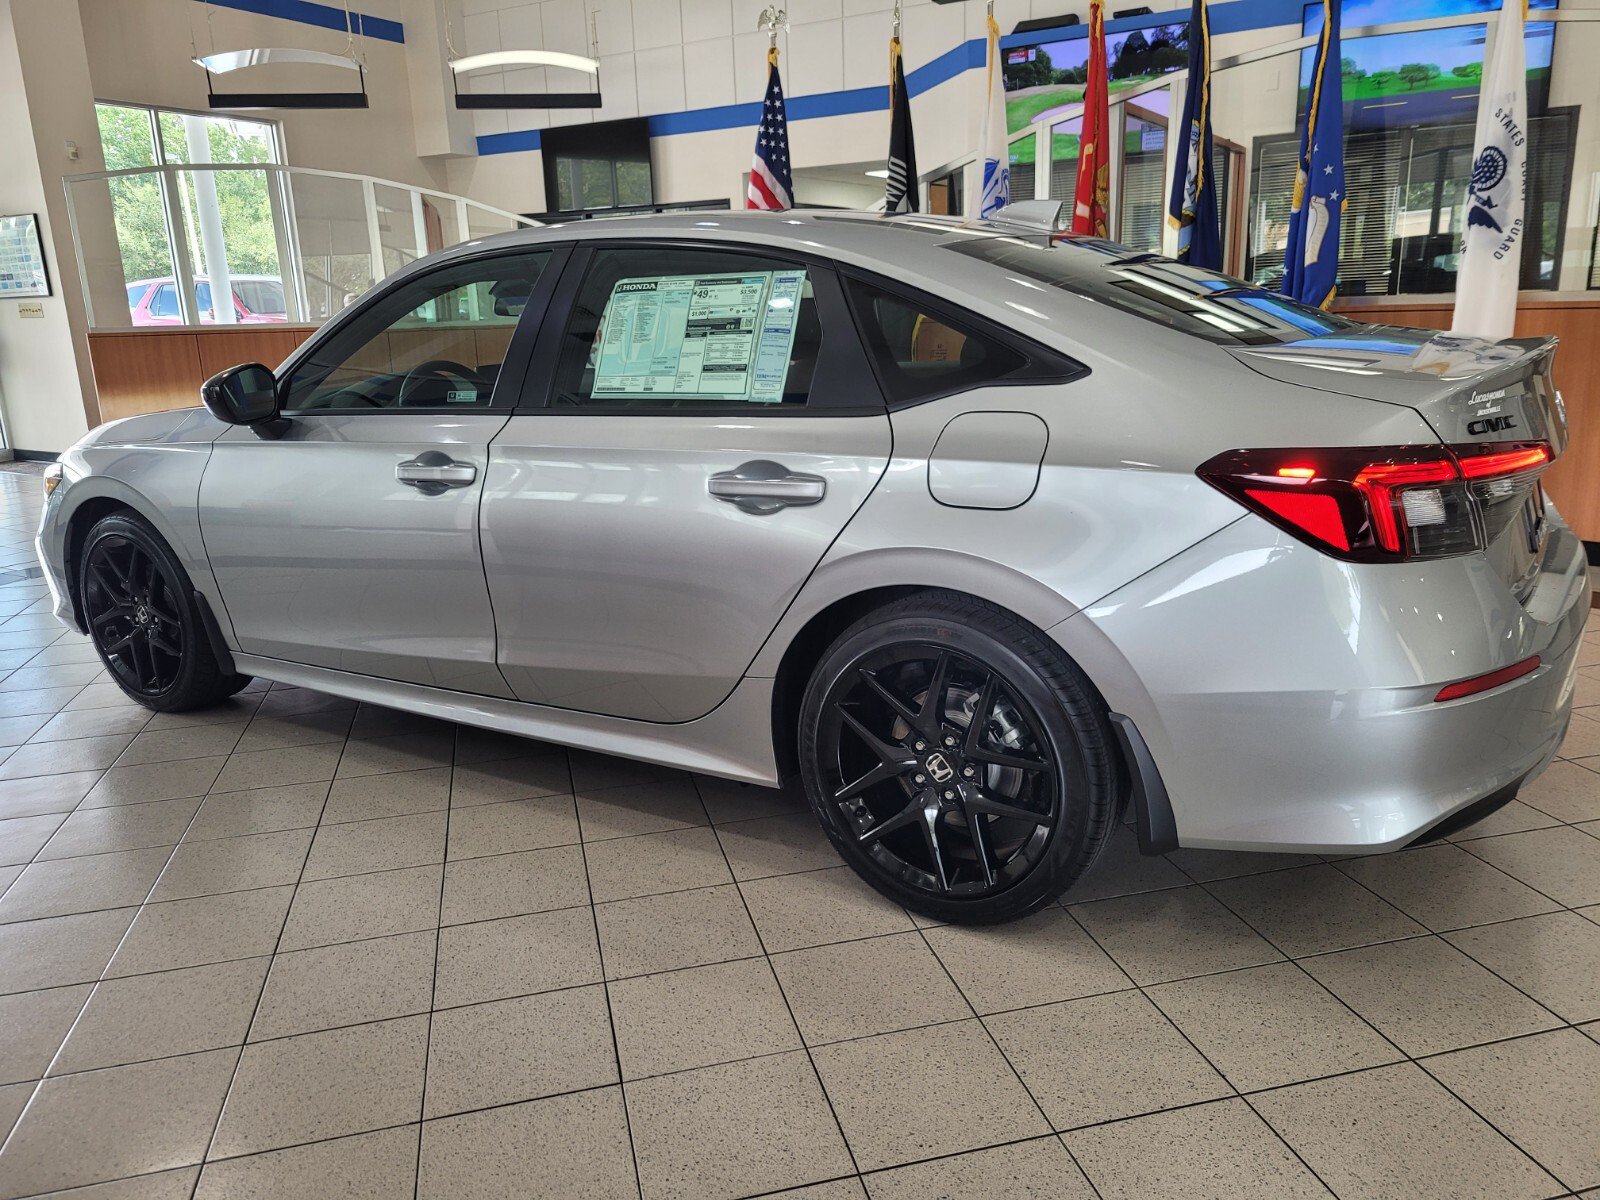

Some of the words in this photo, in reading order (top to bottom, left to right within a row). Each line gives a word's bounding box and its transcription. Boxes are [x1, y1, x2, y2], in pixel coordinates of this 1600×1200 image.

[1494, 107, 1525, 148] STATES
[1493, 218, 1523, 260] GUARD
[696, 289, 709, 299] 49
[1467, 415, 1517, 435] CIVIC
